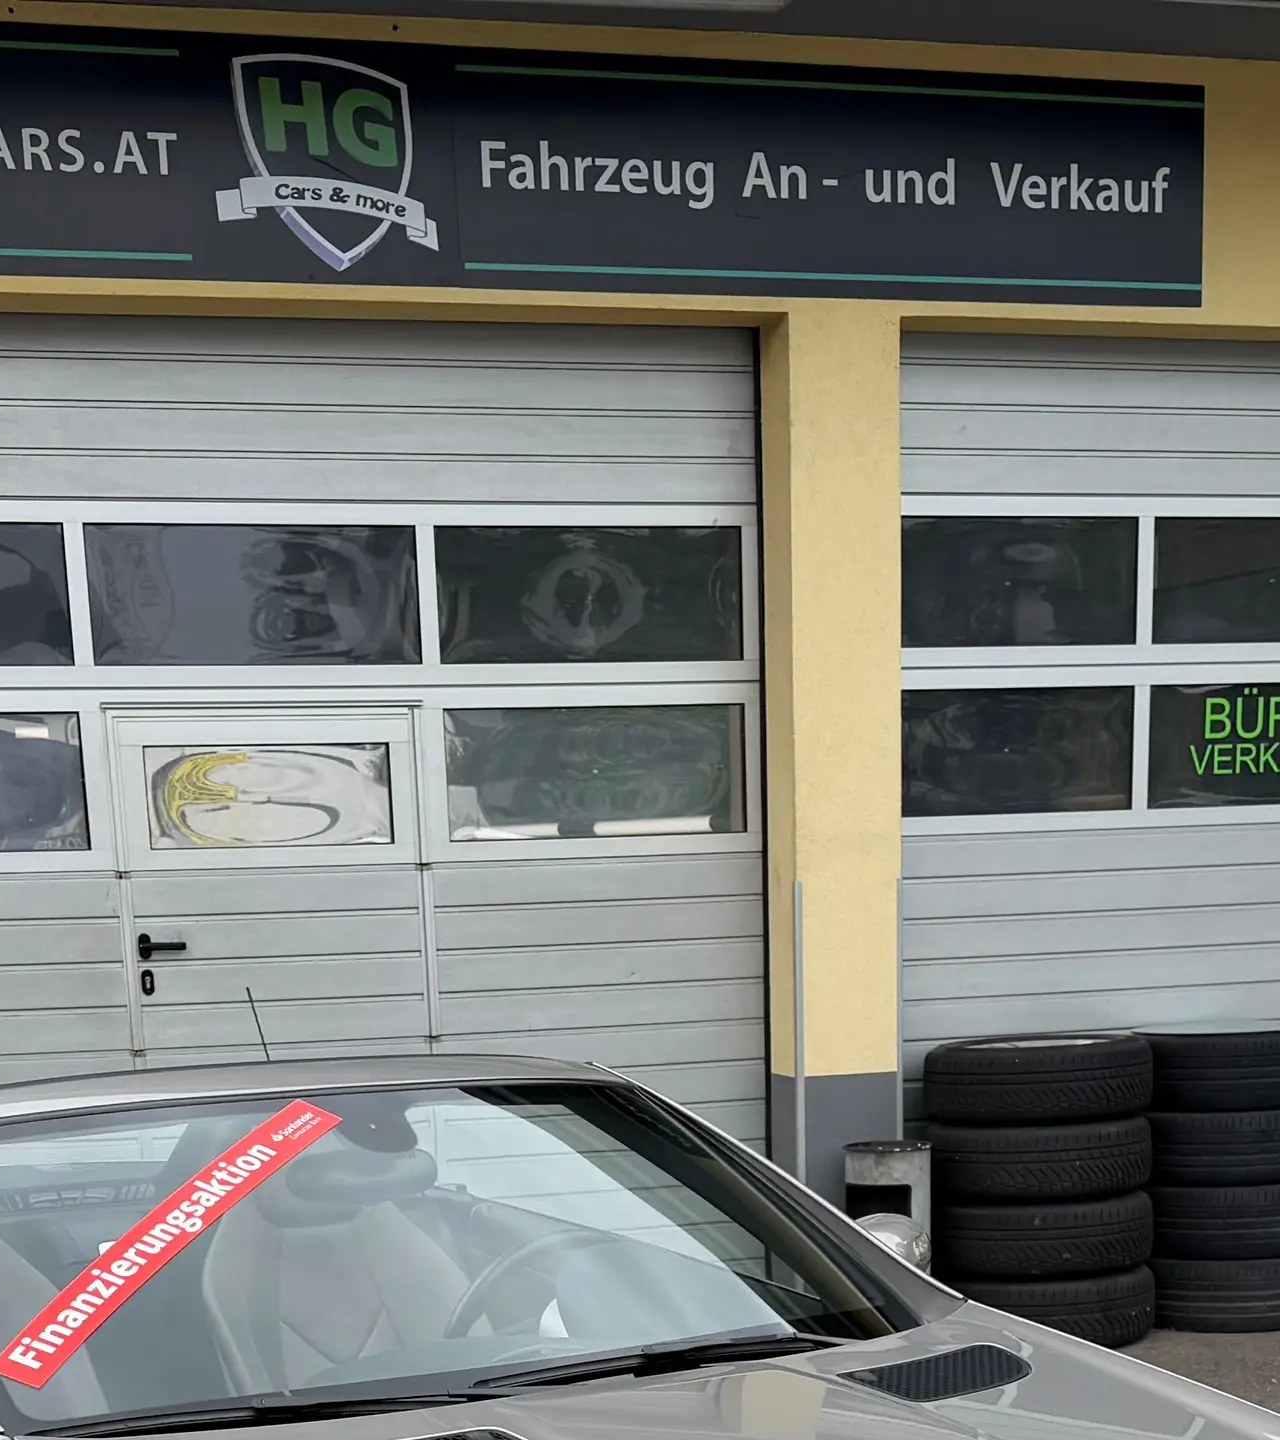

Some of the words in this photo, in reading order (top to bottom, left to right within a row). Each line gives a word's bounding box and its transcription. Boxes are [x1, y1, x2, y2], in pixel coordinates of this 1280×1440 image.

[258, 76, 398, 168] HG
[274, 183, 323, 201] Cars
[329, 187, 351, 204] &
[355, 193, 407, 217] more
[480, 139, 715, 210] Fahrzeug
[865, 157, 956, 206] und
[990, 161, 1171, 215] Verkauf
[8, 1143, 277, 1370] Finanzierungsaktion
